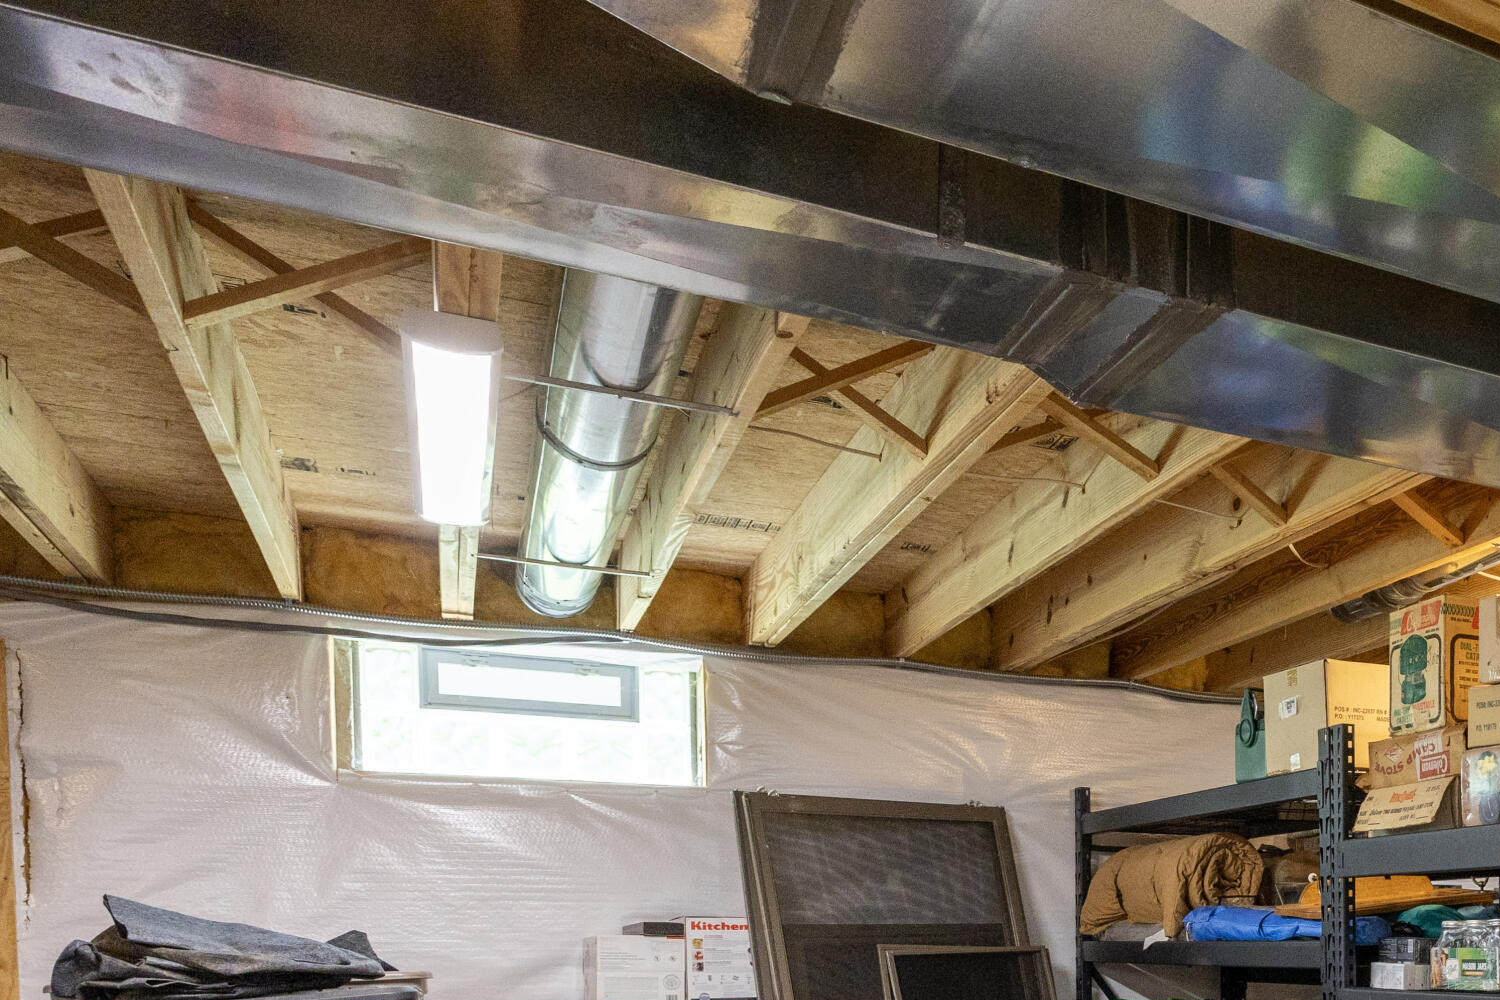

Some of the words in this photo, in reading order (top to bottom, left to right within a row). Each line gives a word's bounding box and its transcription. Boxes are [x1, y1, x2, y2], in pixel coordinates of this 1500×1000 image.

[1406, 743, 1435, 765] CAMP
[1421, 754, 1448, 774] Coleman
[1374, 761, 1404, 775] STOVE
